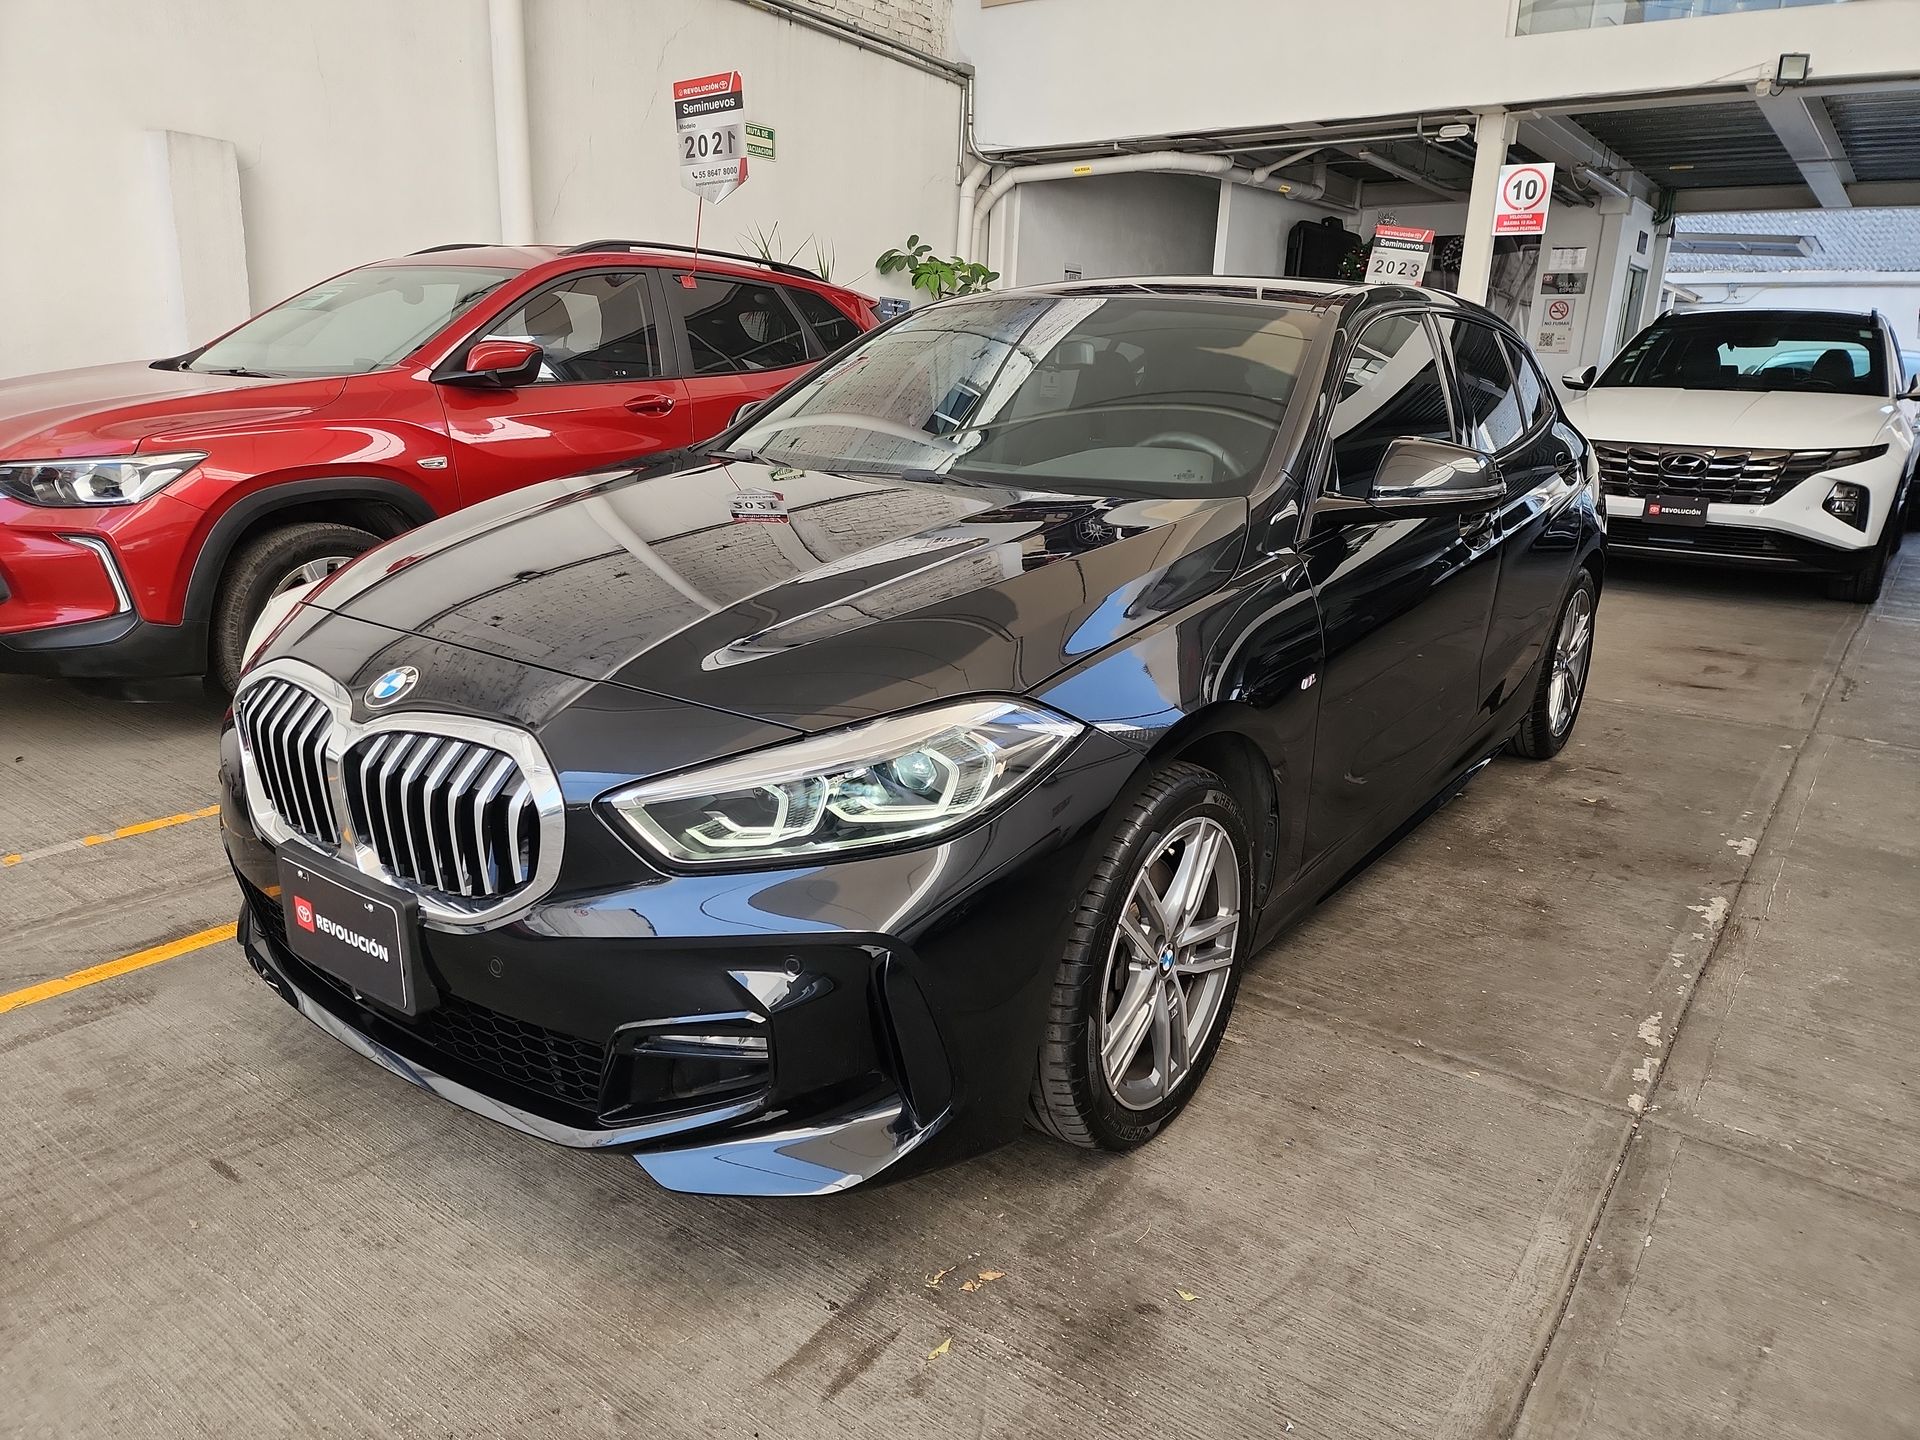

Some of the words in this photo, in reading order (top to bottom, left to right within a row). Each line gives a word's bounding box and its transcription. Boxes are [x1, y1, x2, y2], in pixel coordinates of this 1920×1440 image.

[683, 83, 719, 95] REVOLUCIÓN
[682, 97, 735, 114] Seminuevos
[746, 126, 760, 137] RUTA
[761, 130, 769, 138] DE
[685, 130, 736, 159] 2021
[747, 144, 773, 156] VACUACION
[699, 170, 706, 179] 55
[707, 168, 721, 178] 8647
[723, 166, 737, 176] 8000
[1512, 179, 1538, 200] 10
[1380, 238, 1424, 251] Seminuevos
[1374, 259, 1420, 277] 2023
[1661, 507, 1702, 516] REVOLUCIÓN
[316, 914, 389, 963] REVOLUCIÓN
